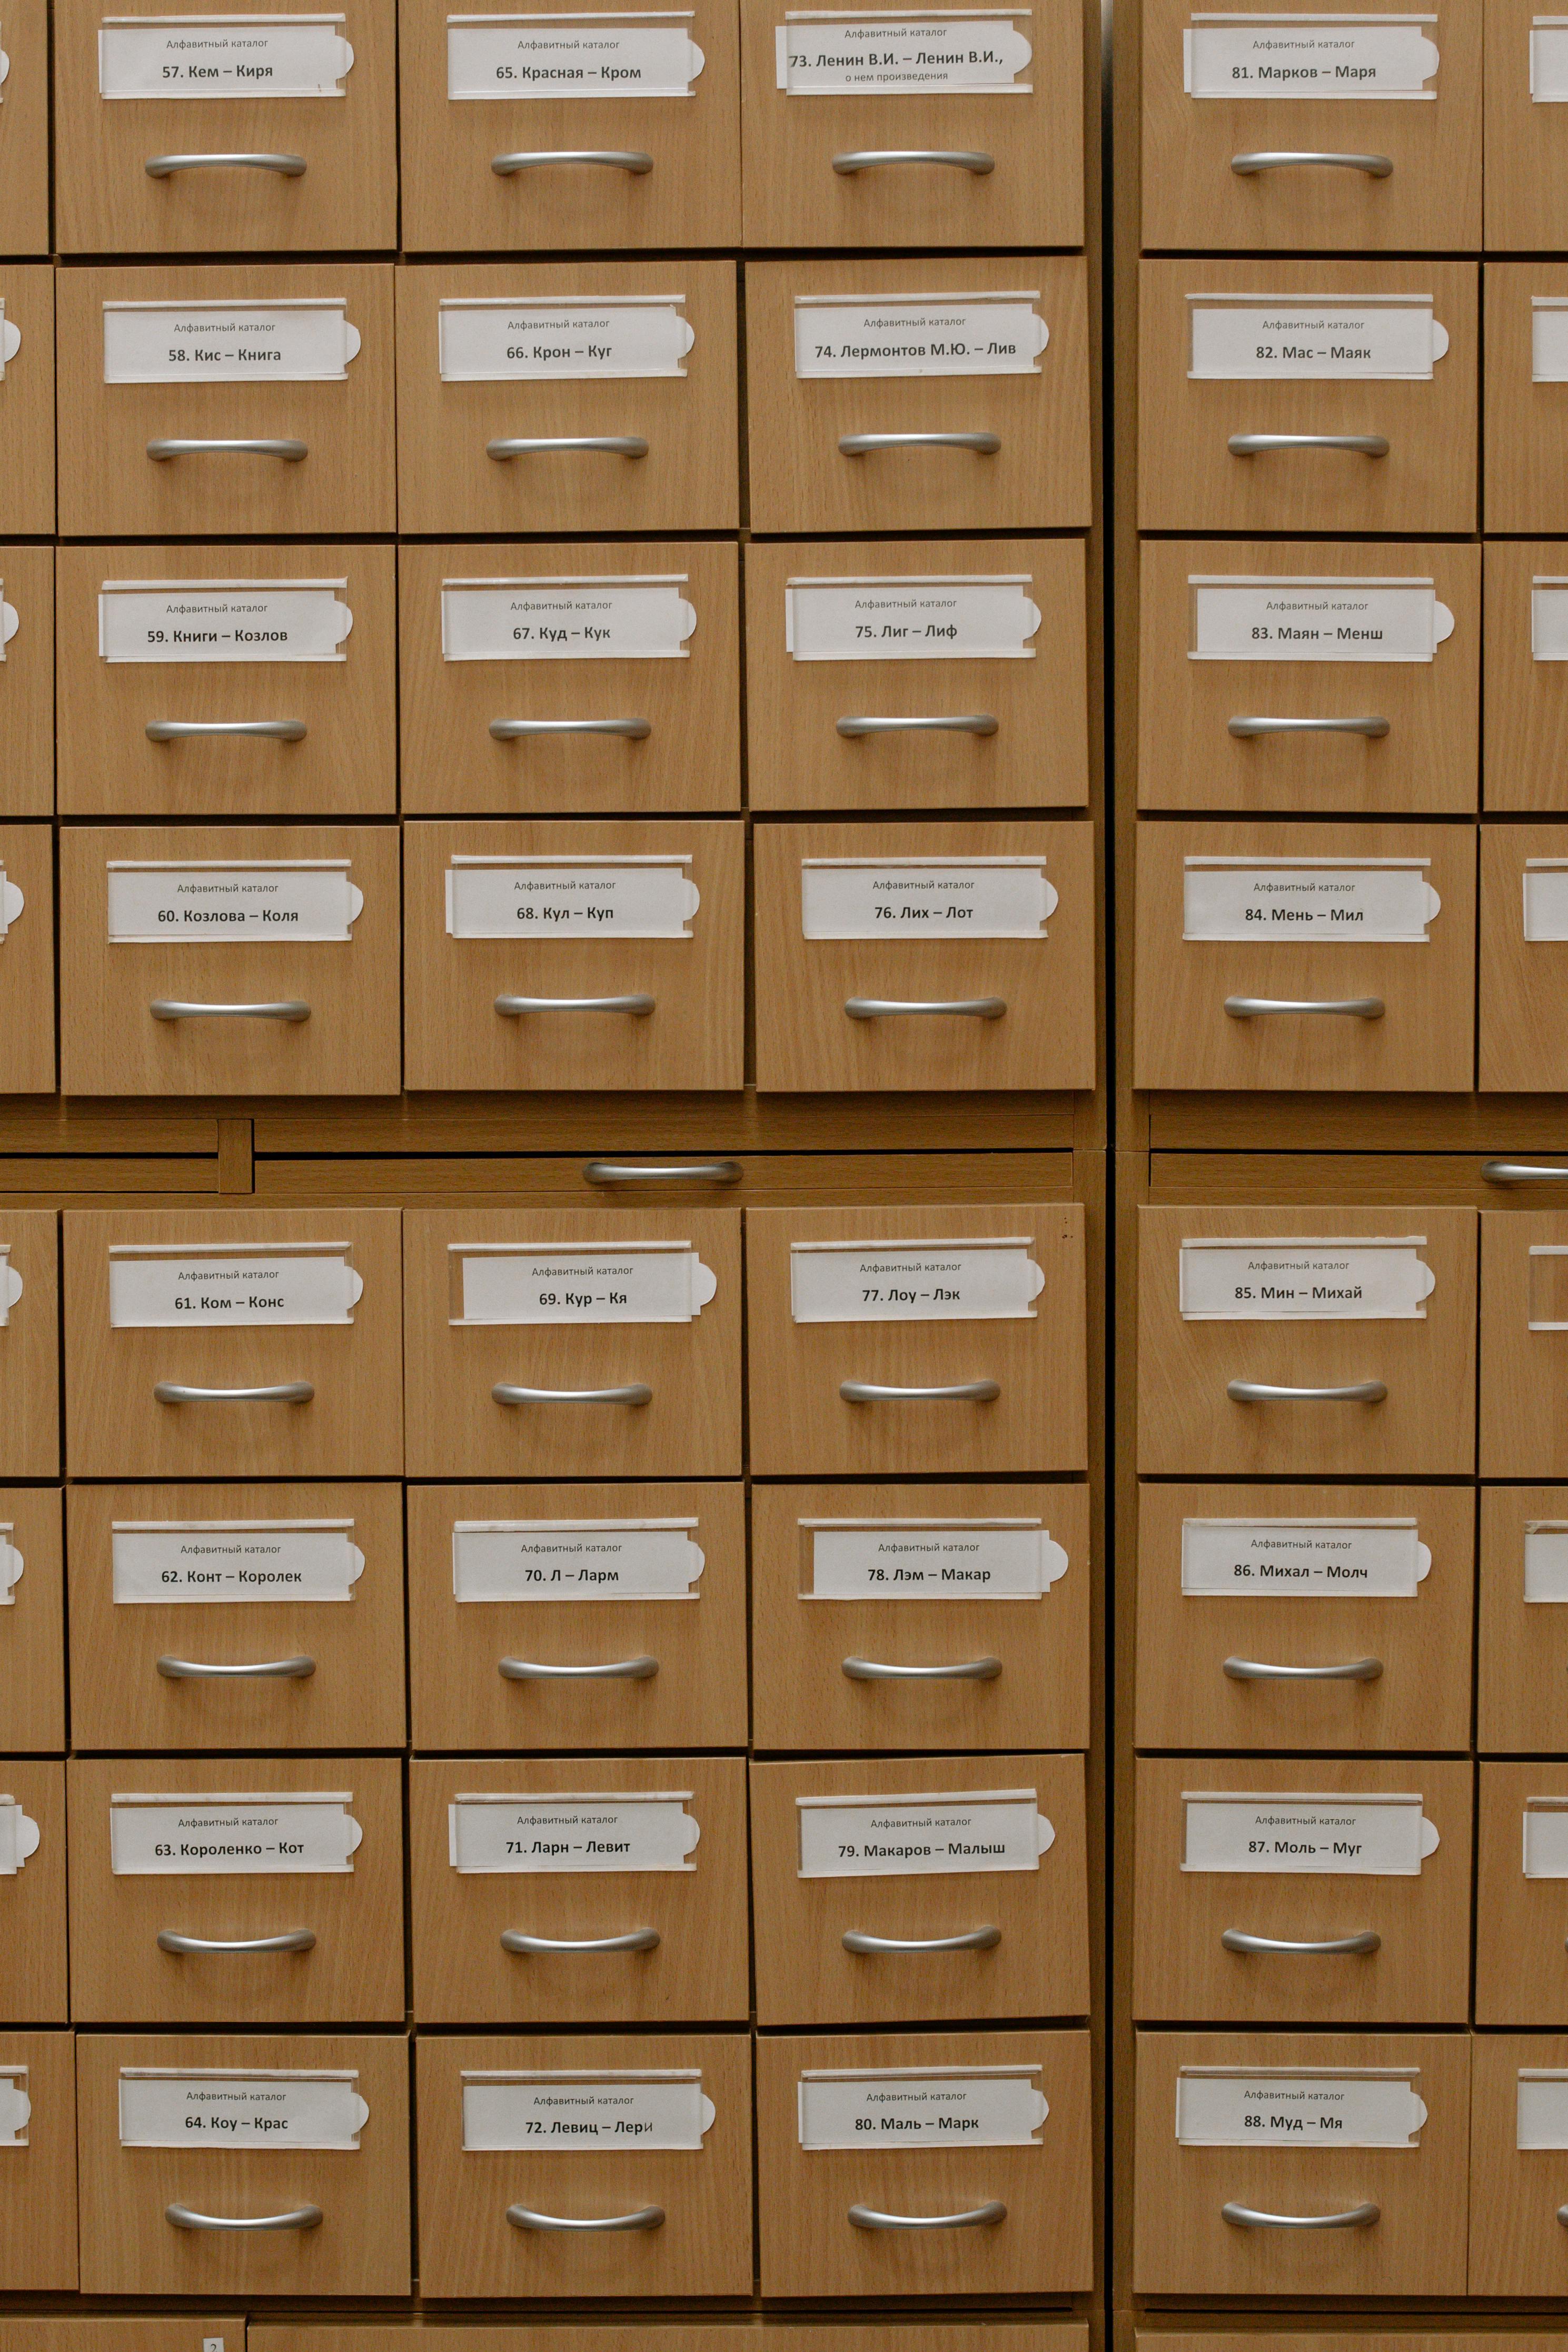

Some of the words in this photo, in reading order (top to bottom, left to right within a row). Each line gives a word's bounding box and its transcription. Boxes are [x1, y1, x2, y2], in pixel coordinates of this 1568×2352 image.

[845, 28, 907, 40] Алфавитный
[166, 39, 228, 51] Алфавитный
[788, 55, 812, 67] 73.
[816, 54, 864, 67] Ленин
[869, 53, 899, 66] В.И.
[915, 52, 964, 65] Ленин
[969, 50, 1003, 65] В.И.,
[162, 66, 184, 78] 57.
[188, 65, 219, 78] Кем
[236, 64, 273, 80] Киря
[496, 66, 518, 79] 65.
[522, 66, 583, 82] Красная
[601, 66, 641, 82] Кром
[877, 73, 948, 83] произведения
[1232, 66, 1254, 79] 81.
[1258, 66, 1318, 82] Марков
[1335, 65, 1376, 81] Маря
[1262, 320, 1325, 331] Алфавитный
[168, 349, 190, 362] 58.
[195, 349, 221, 362] Кис
[238, 349, 281, 361] Книга
[507, 346, 528, 359] 66.
[533, 346, 571, 362] Крон
[588, 345, 612, 360] Куг
[815, 345, 836, 359] 74.
[840, 345, 926, 361] Лермонтов
[930, 343, 970, 356] М.Ю.
[987, 342, 1016, 355] Лив
[1256, 346, 1278, 359] 82.
[1283, 346, 1314, 359] Мас
[1331, 346, 1371, 359] Маяк
[510, 600, 572, 612] Алфавитный
[147, 630, 168, 643] 59.
[173, 630, 217, 643] Книги
[235, 629, 288, 642] Козлов
[513, 627, 534, 640] 67.
[539, 627, 568, 642] Куд
[584, 626, 611, 642] Кук
[855, 626, 877, 638] 75.
[881, 625, 909, 638] Лиг
[925, 624, 958, 640] Лиф
[1251, 627, 1273, 640] 83.
[1278, 627, 1319, 640] Маян
[1337, 627, 1383, 640] Менш
[1253, 882, 1315, 894] Алфавитный
[157, 910, 179, 922] 60.
[184, 910, 245, 922] Козлова
[262, 909, 299, 922] Коля
[517, 907, 539, 920] 68.
[543, 907, 570, 922] Кул
[587, 907, 613, 922] Куп
[874, 906, 896, 919] 76.
[900, 906, 929, 919] Лих
[945, 906, 974, 919] Лот
[1245, 908, 1267, 921] 84.
[1272, 909, 1314, 921] Мень
[1331, 909, 1364, 921] Мил
[859, 1263, 921, 1274] Алфавитный
[862, 1289, 884, 1302] 77.
[887, 1289, 917, 1304] Лоу
[932, 1288, 960, 1301] Лэк
[1235, 1287, 1256, 1299] 85.
[1261, 1287, 1295, 1299] Мин
[1312, 1285, 1362, 1299] Михай
[175, 1297, 196, 1310] 61.
[201, 1297, 232, 1309] Ком
[249, 1296, 284, 1308] Конс
[539, 1293, 561, 1305] 69.
[565, 1293, 592, 1308] Кур
[609, 1292, 627, 1304] Кя
[161, 1571, 183, 1583] 62.
[187, 1570, 222, 1583] Конт
[239, 1570, 302, 1585] Королек
[524, 1569, 547, 1582] 70.
[550, 1569, 561, 1582] Л
[578, 1569, 619, 1584] Ларм
[867, 1569, 889, 1581] 78.
[892, 1569, 924, 1581] Лэм
[941, 1569, 991, 1583] Макар
[1234, 1564, 1255, 1577] 86.
[1260, 1564, 1309, 1577] Михал
[1327, 1566, 1368, 1579] Молч
[155, 1844, 176, 1857] 63.
[181, 1843, 262, 1859] Короленко
[279, 1842, 304, 1854] Кот
[505, 1841, 527, 1854] 71.
[531, 1841, 569, 1857] Ларн
[585, 1841, 631, 1853] Левит
[838, 1845, 859, 1858] 79.
[864, 1844, 931, 1859] Макаров
[948, 1842, 1005, 1855] Малыш
[1248, 1841, 1269, 1853] 87.
[1274, 1841, 1316, 1854] Моль
[1333, 1842, 1363, 1857] Муг
[1244, 2090, 1305, 2101] Алфавитный
[185, 2116, 206, 2129] 64.
[211, 2117, 238, 2132] Коу
[254, 2117, 289, 2132] Крас
[525, 2121, 547, 2134] 72.
[550, 2121, 599, 2136] Левиц
[855, 2118, 876, 2131] 80.
[881, 2118, 922, 2130] Маль
[938, 2117, 979, 2132] Марк
[1244, 2115, 1265, 2128] 88.
[1270, 2116, 1303, 2131] Муд
[1320, 2117, 1343, 2129] Мя
